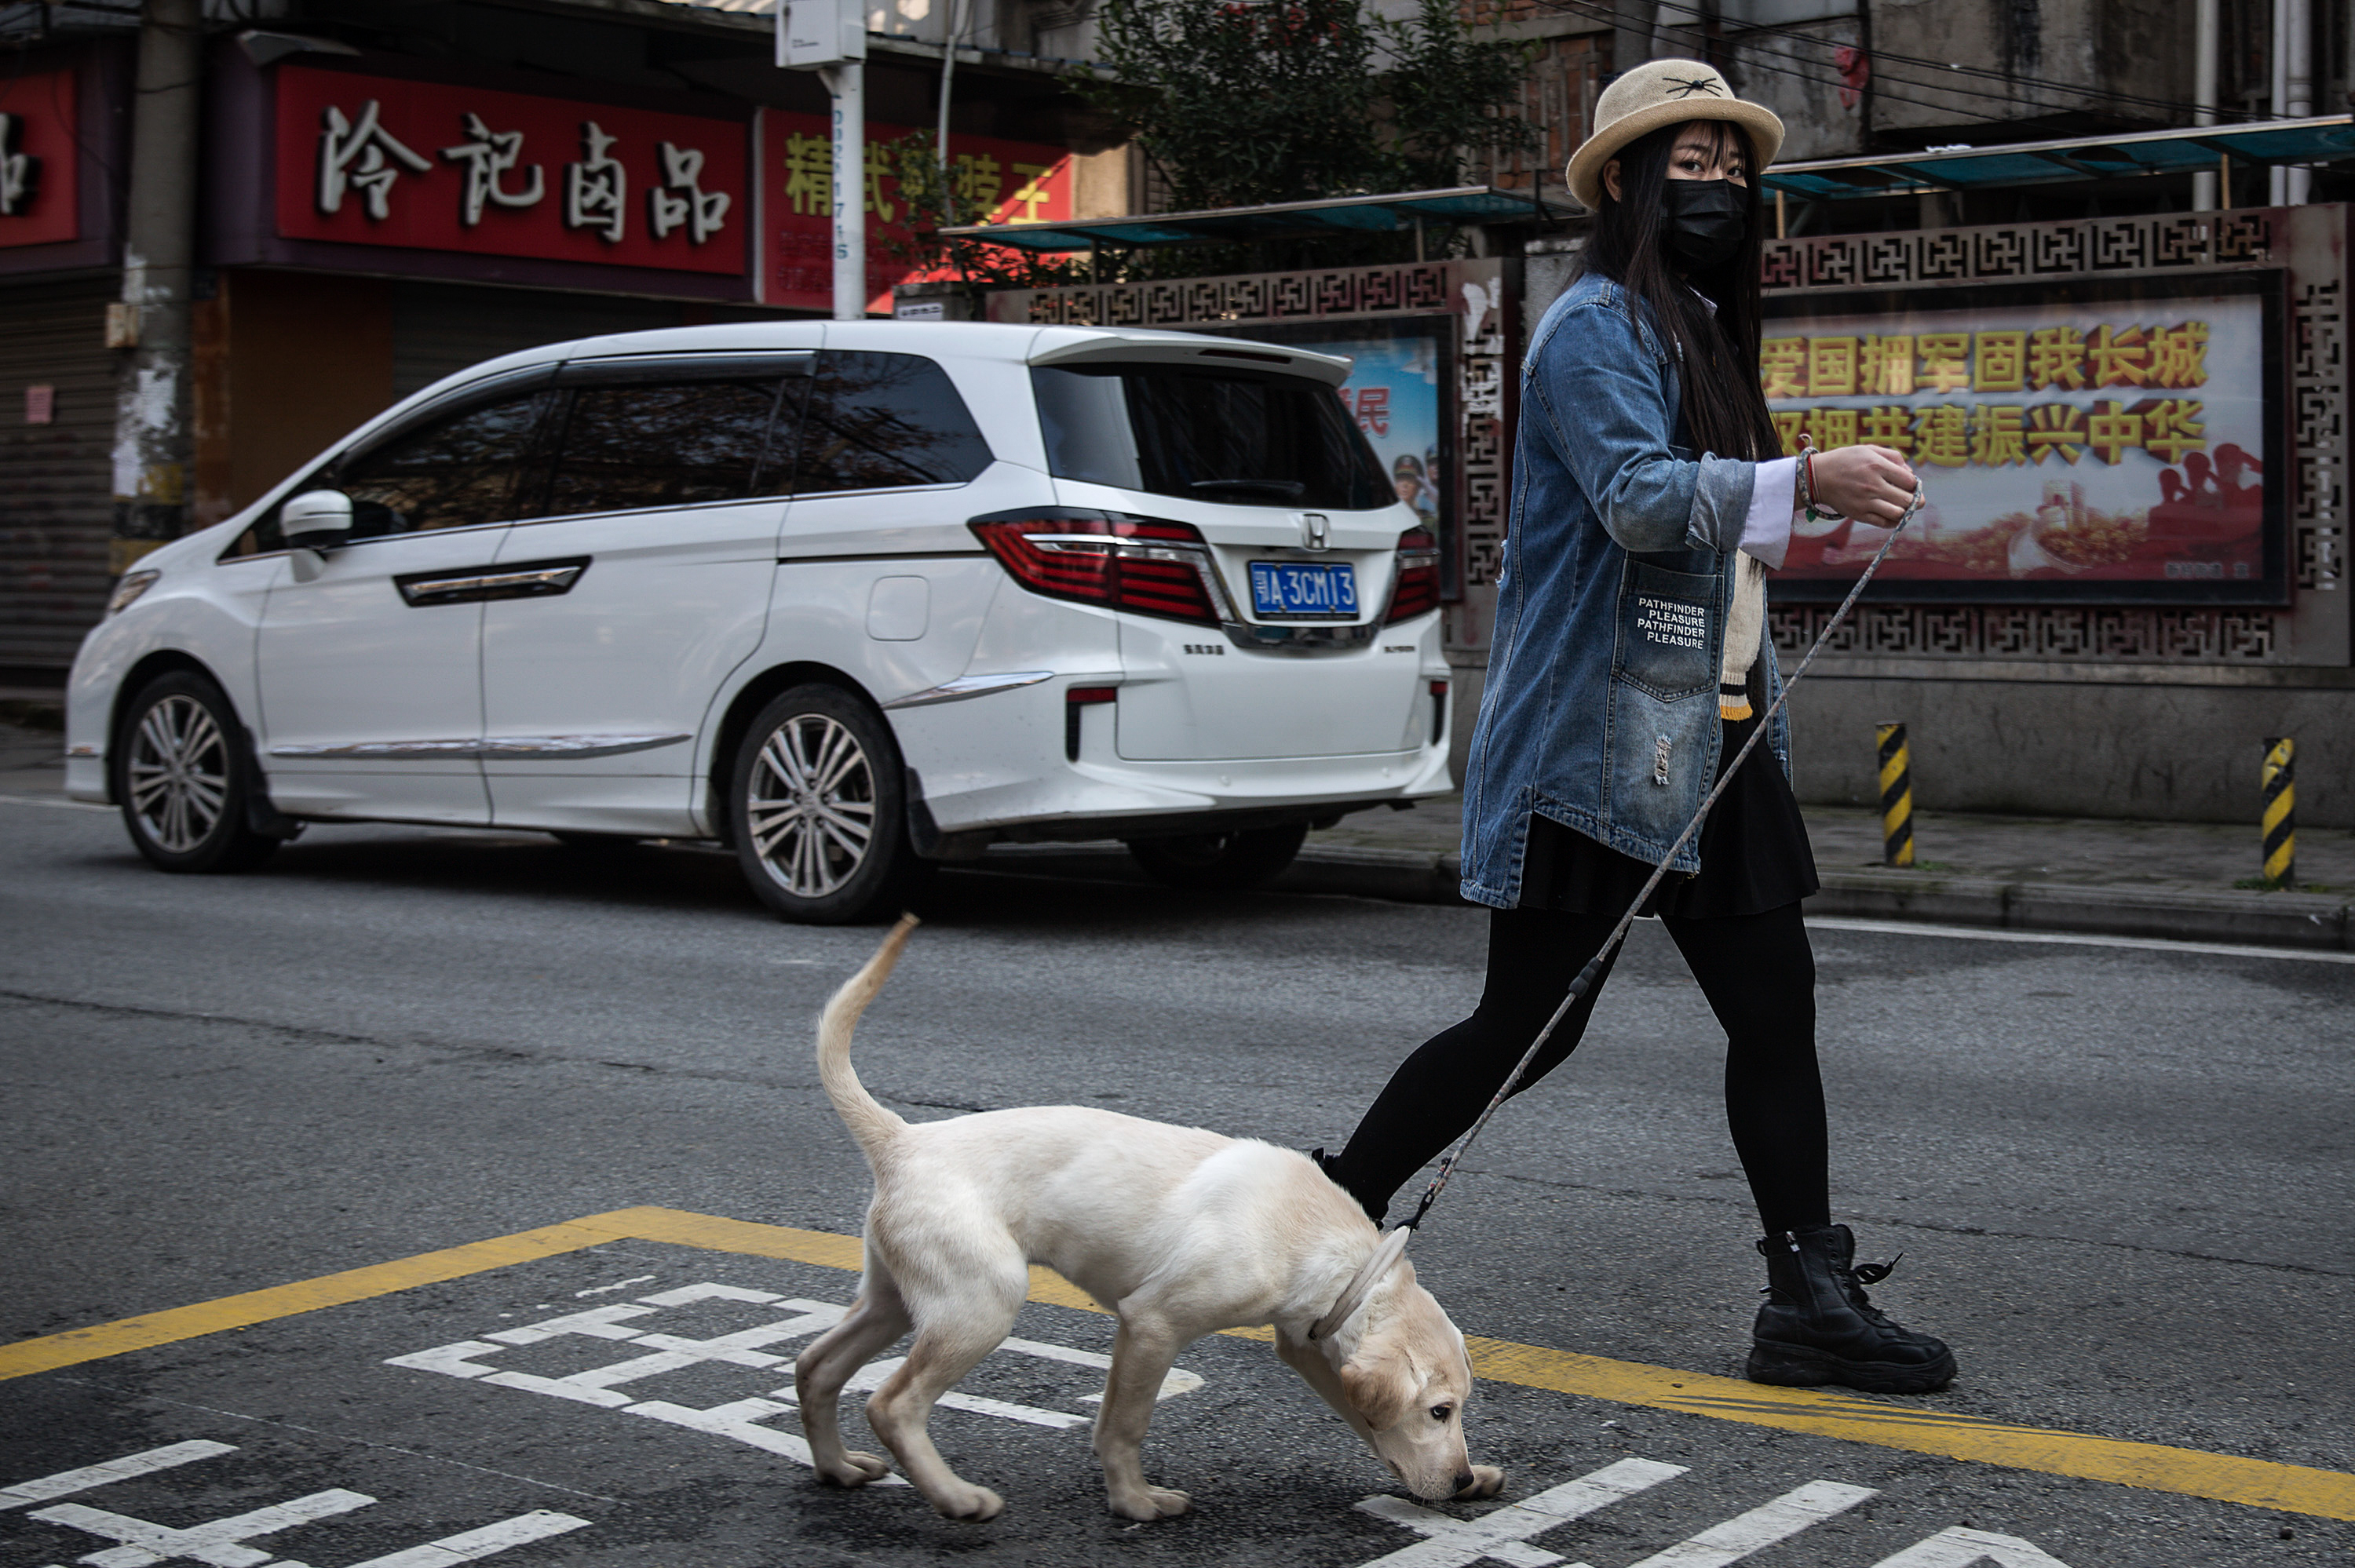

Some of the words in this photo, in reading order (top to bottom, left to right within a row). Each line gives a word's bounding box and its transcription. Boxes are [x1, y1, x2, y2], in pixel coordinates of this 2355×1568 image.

[1761, 321, 2211, 398] 爱国拥军固我长城
[1638, 596, 1705, 618] PATHFINDER
[1637, 618, 1705, 639] PATHFINDER
[1648, 609, 1706, 628] PLEASURE
[1646, 631, 1704, 650] PLEASURE
